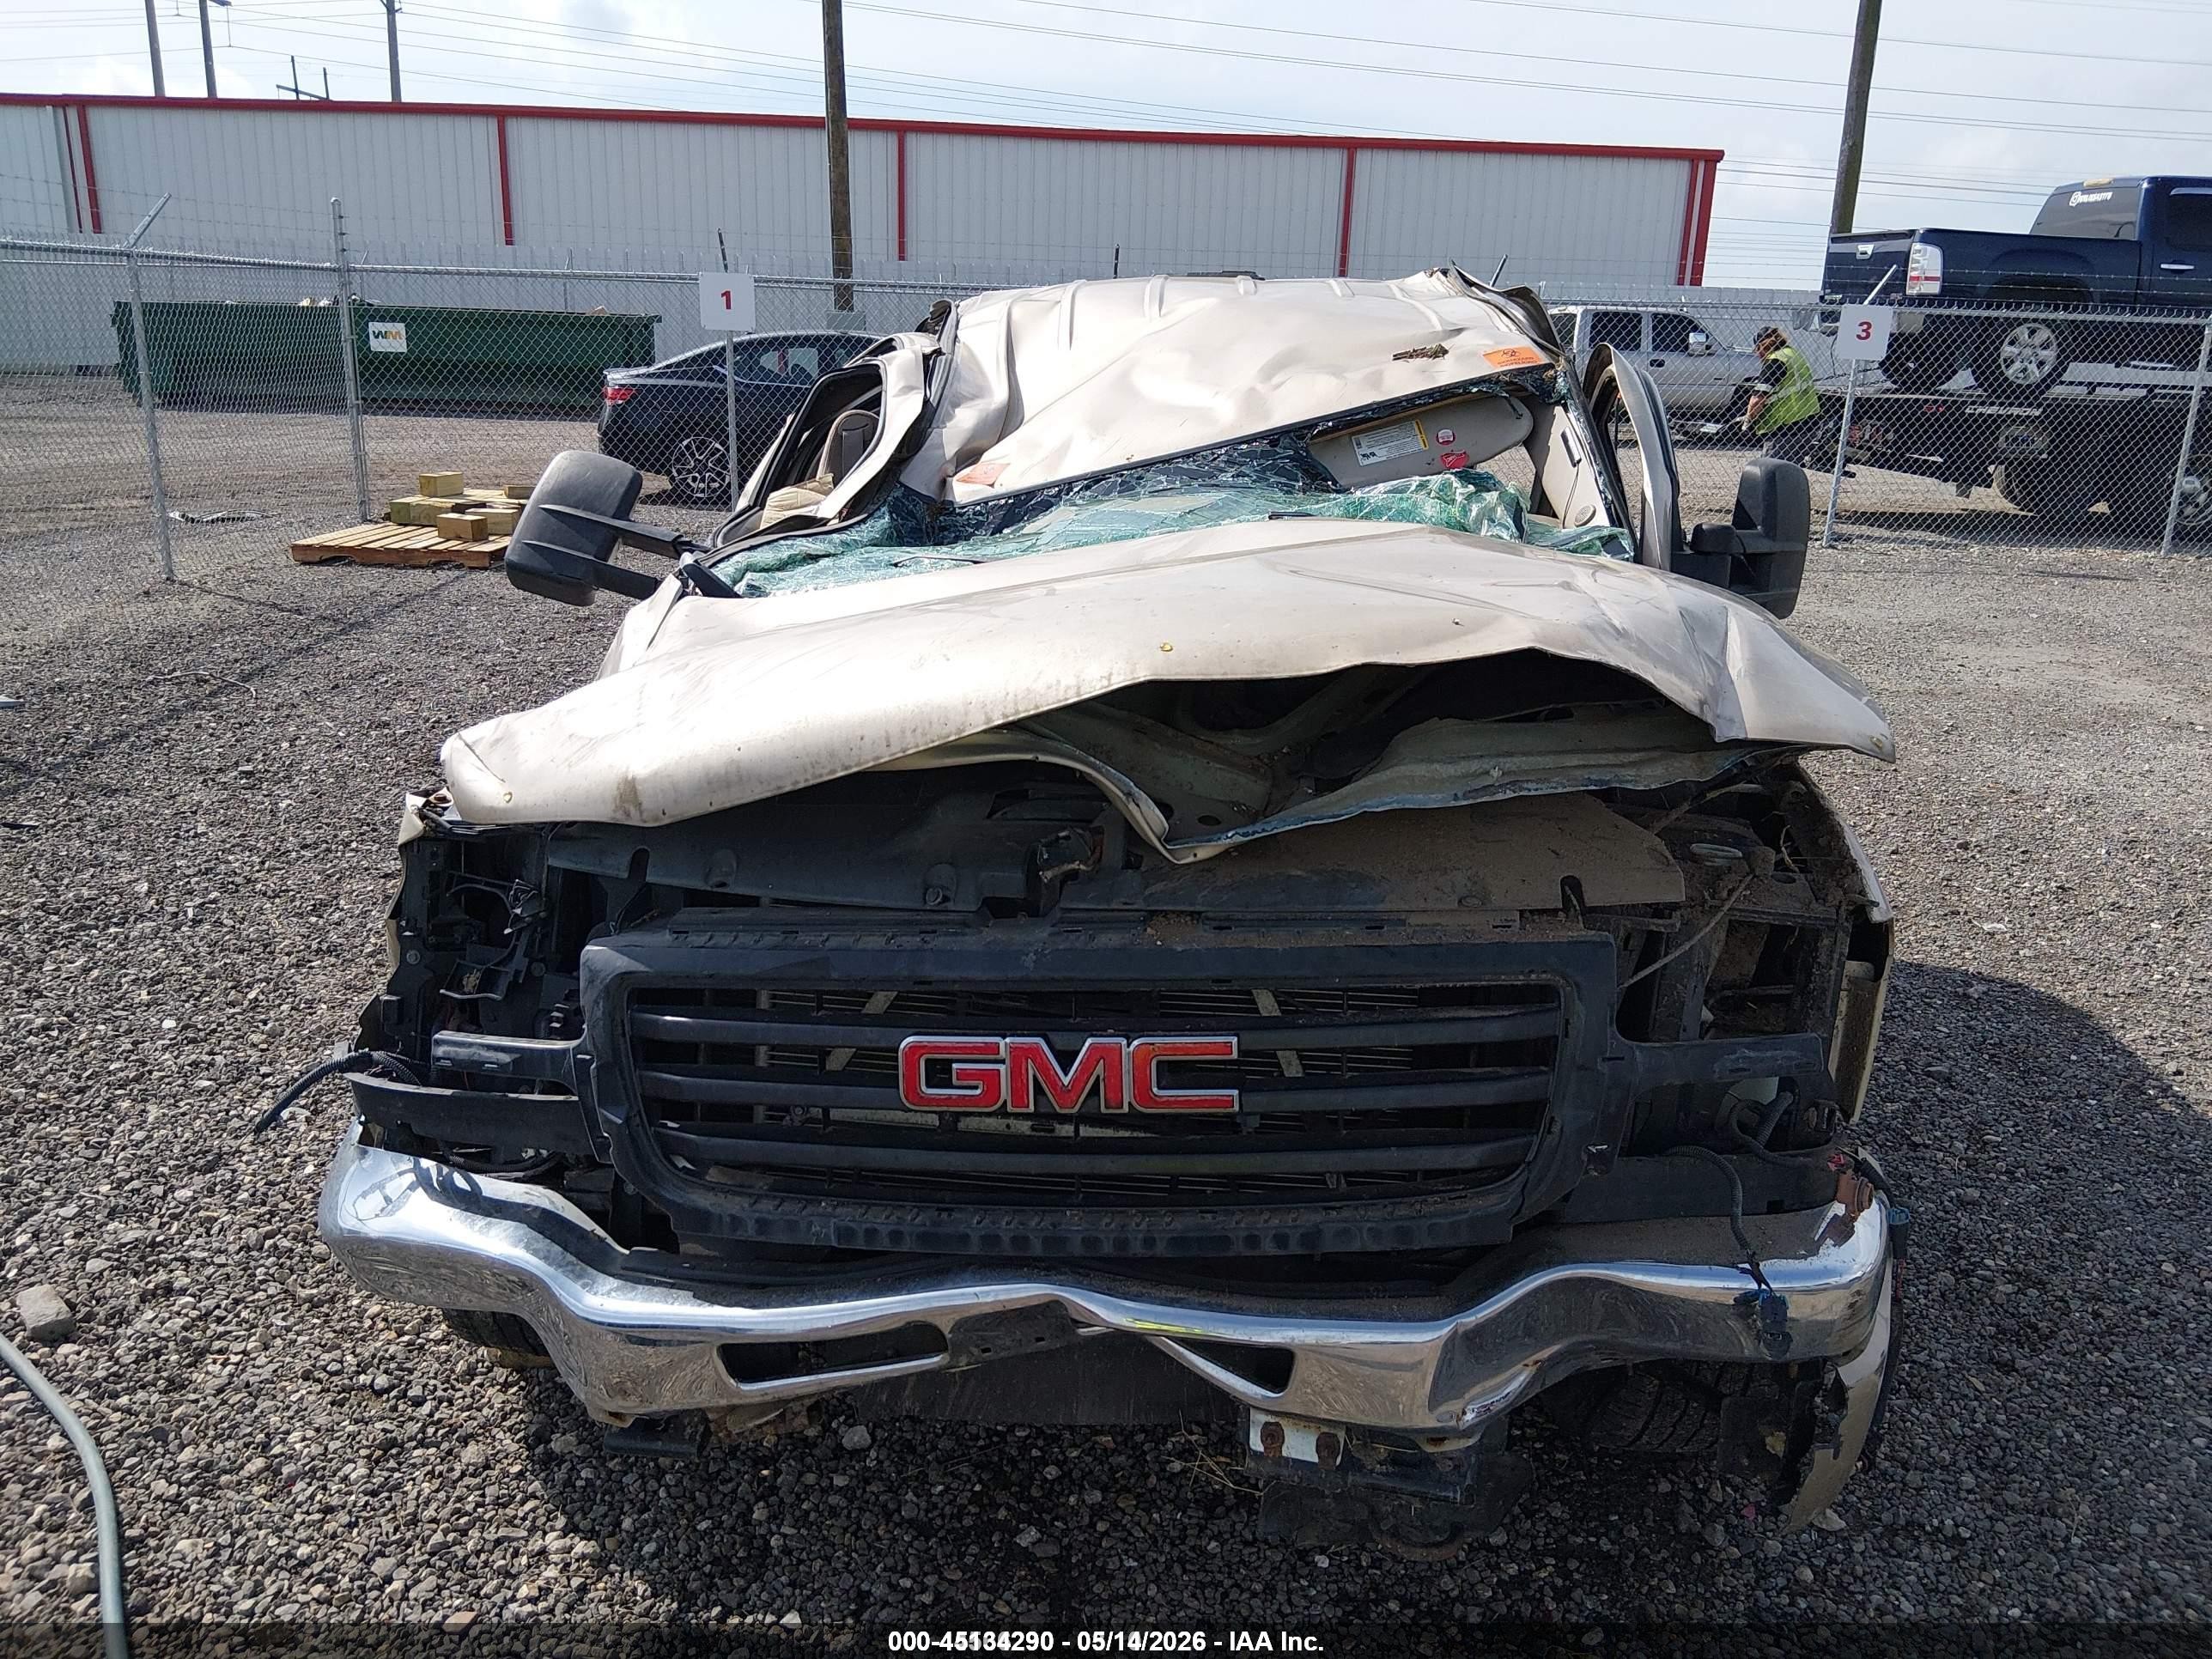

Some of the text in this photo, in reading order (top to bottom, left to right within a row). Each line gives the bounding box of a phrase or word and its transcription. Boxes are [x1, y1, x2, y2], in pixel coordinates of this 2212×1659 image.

[720, 290, 732, 310] 1
[1856, 321, 1873, 341] 3
[1965, 405, 2043, 416] CHEVRON
[898, 1036, 1239, 1114] GMC
